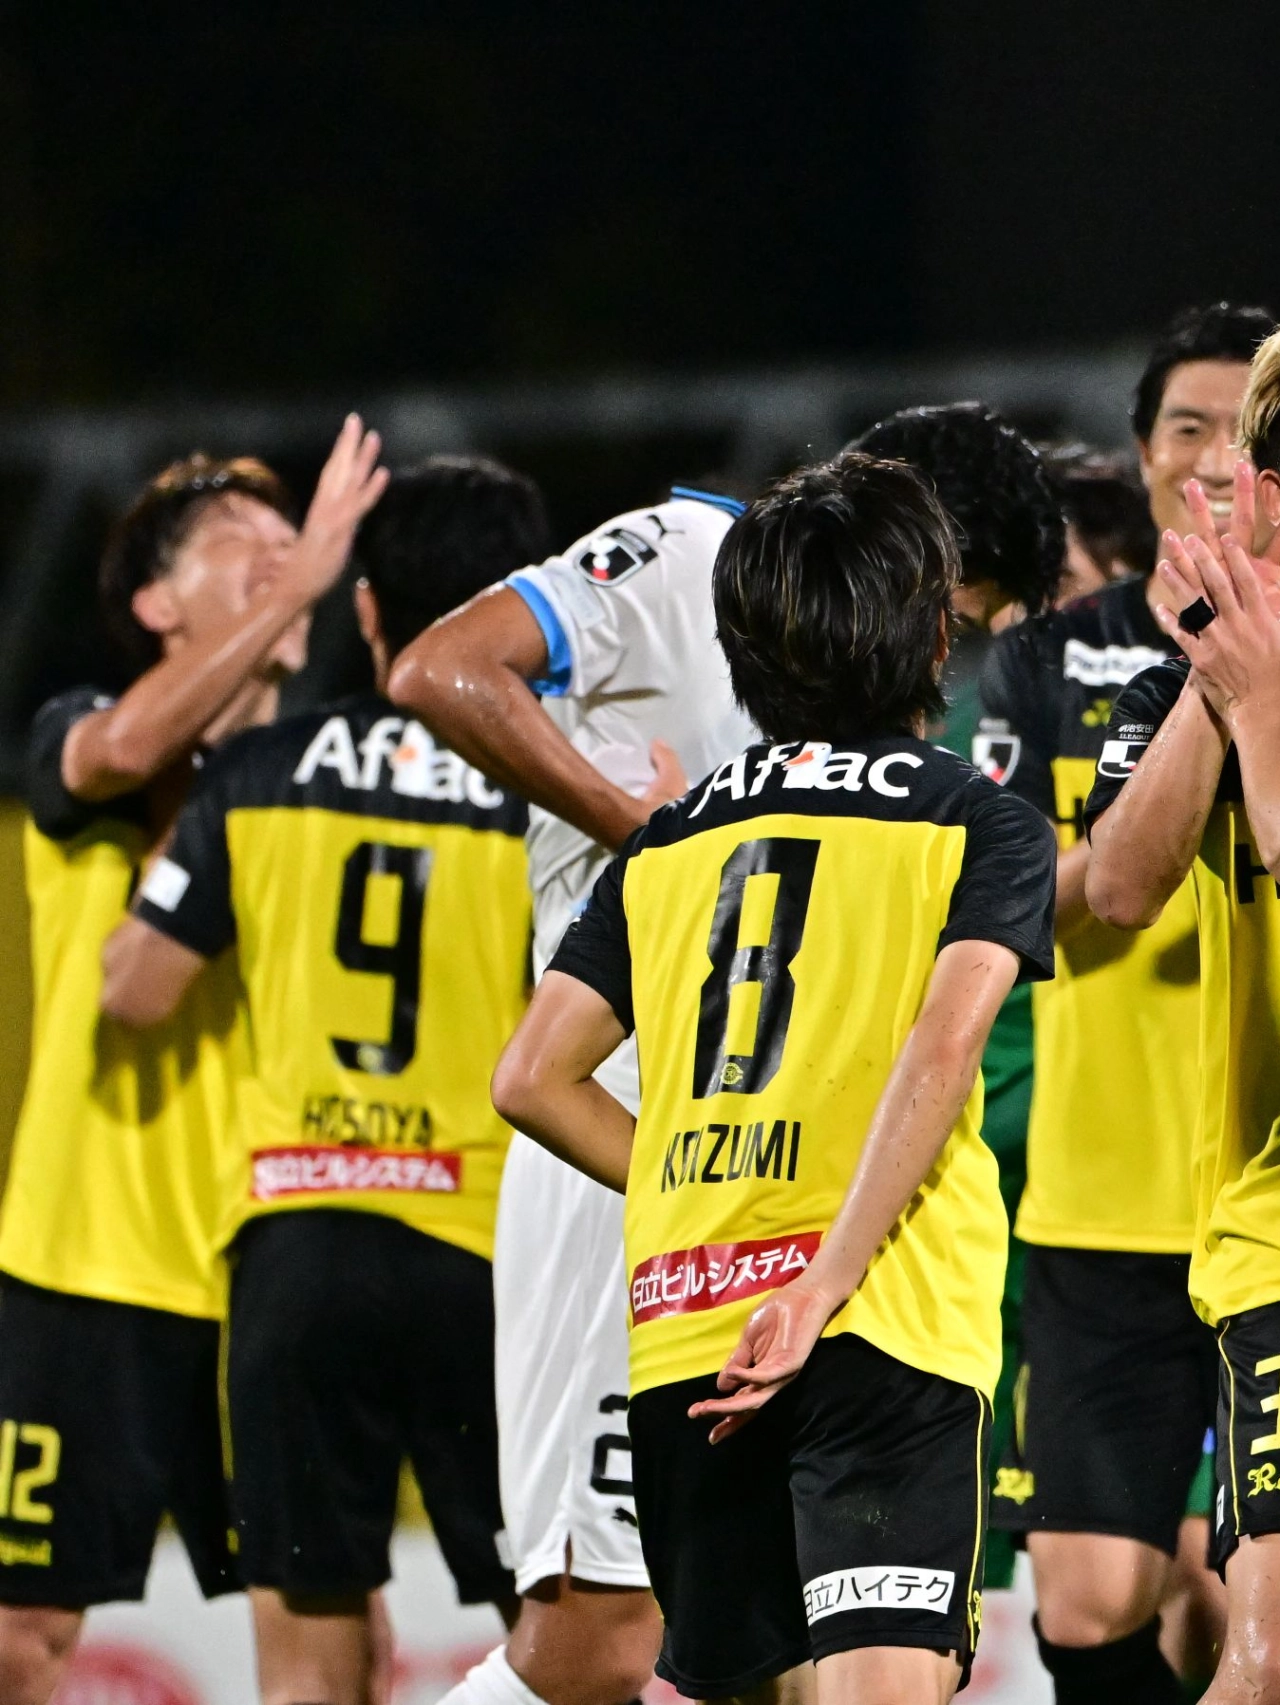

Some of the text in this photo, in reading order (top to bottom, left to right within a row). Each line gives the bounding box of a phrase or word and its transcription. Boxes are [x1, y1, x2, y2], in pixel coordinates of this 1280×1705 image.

[329, 842, 434, 1076] 9
[692, 837, 821, 1099] 8
[632, 1244, 810, 1312] 日立ビルシステム
[804, 1573, 949, 1620] 日立ハイテク
